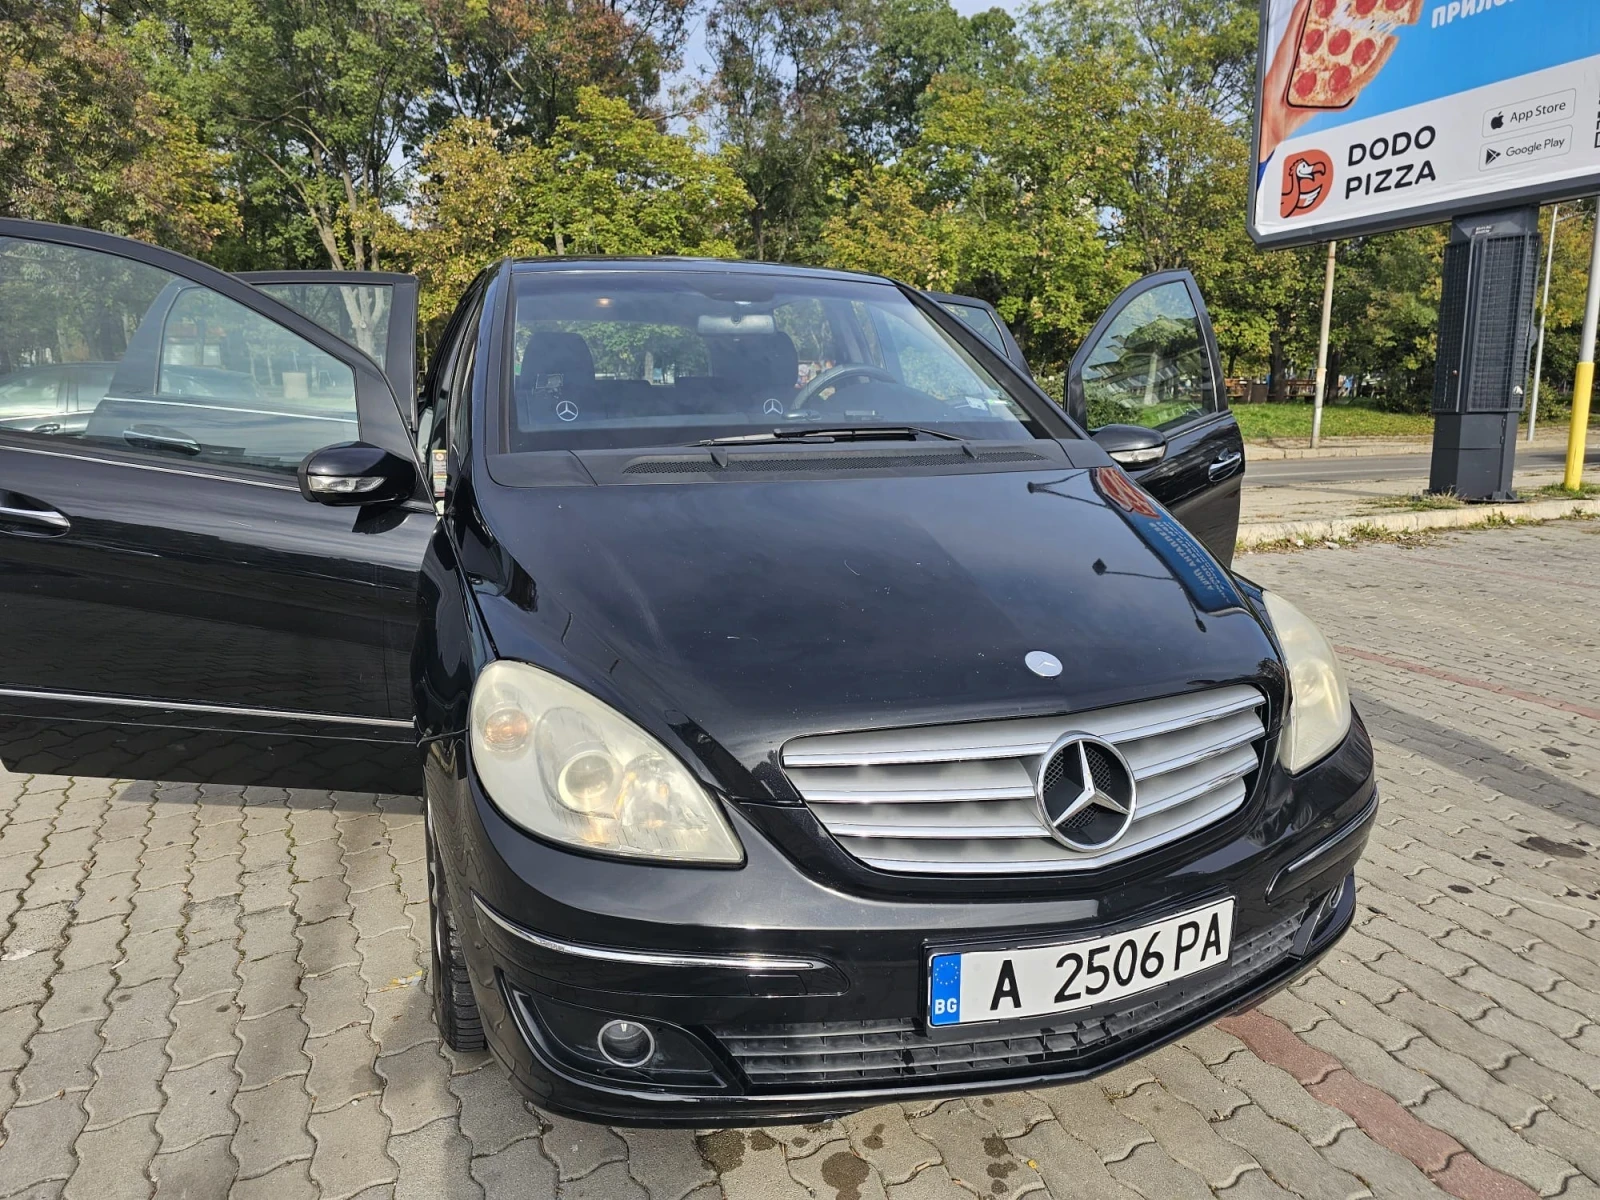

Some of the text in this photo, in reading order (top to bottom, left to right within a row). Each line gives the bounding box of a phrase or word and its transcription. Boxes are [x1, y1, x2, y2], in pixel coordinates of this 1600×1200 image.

[1510, 102, 1566, 123] App Store
[1348, 125, 1436, 167] DODO
[1505, 138, 1565, 157] Google Play
[1345, 160, 1436, 199] PIZZA
[990, 912, 1222, 1011] A 2506 PA
[934, 998, 957, 1015] BG
